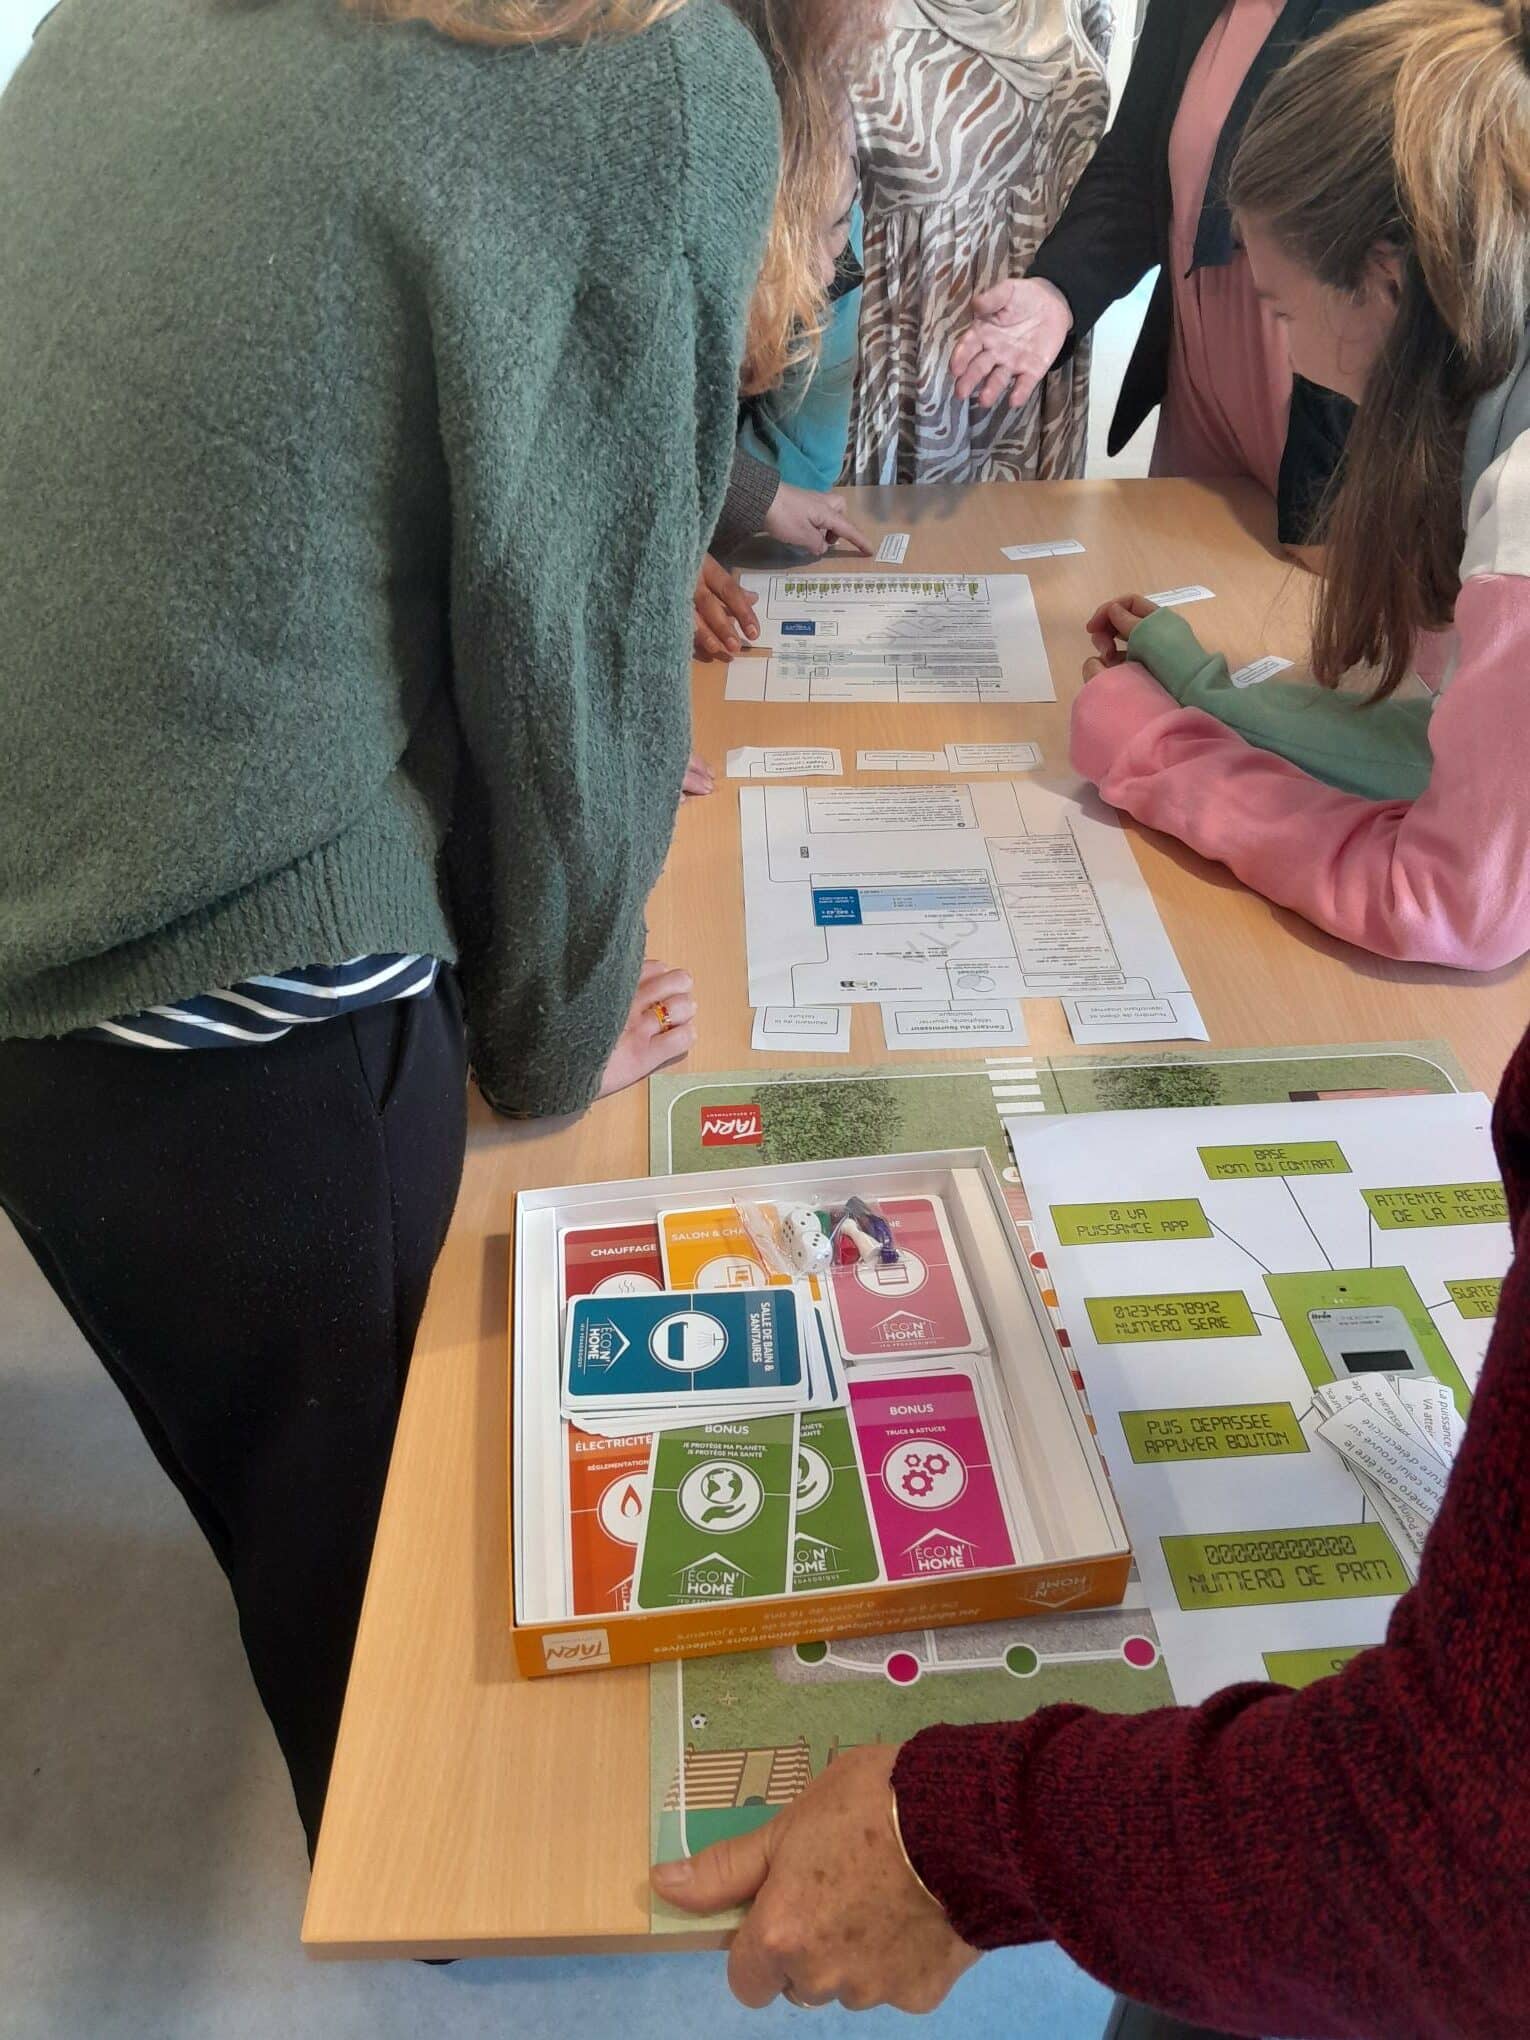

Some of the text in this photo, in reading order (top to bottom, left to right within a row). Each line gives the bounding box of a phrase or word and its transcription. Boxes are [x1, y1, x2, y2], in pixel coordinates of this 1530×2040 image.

[702, 1116, 762, 1139] TARN
[1254, 1148, 1288, 1161] BASE
[1216, 1158, 1337, 1174] NOM DU CONTRAT
[1374, 1187, 1505, 1207] ATTENTE RETOU
[1126, 1208, 1148, 1220] VA
[1392, 1203, 1507, 1224] DE LA TENSIO
[671, 1231, 709, 1241] SALON
[1076, 1220, 1189, 1238] PUISSANCE APP
[591, 1243, 656, 1257] CHAUFFAGE
[1115, 1316, 1231, 1336] NUMERO SERIE
[587, 1328, 601, 1361] HOME
[750, 1313, 762, 1363] SANITAIRES
[761, 1302, 775, 1372] SALLE DE BAIN &
[885, 1330, 926, 1341] HOME
[890, 1403, 934, 1416] BONUS
[704, 1424, 749, 1434] BONUS
[885, 1428, 908, 1437] TRUCS
[915, 1425, 946, 1434] ASTUCES
[1146, 1413, 1272, 1435] PUIS DEPASSEE
[1343, 1420, 1364, 1438] sur
[1144, 1431, 1290, 1454] APPUYER BOUTON
[1342, 1438, 1436, 1516] uméro doit être le
[1396, 1464, 1423, 1487] celui
[794, 1560, 828, 1574] OME
[918, 1558, 965, 1571] HOME
[1187, 1559, 1393, 1594] NUMERO DE PRM
[687, 1583, 734, 1596] HOME
[545, 1641, 609, 1661] TARN
[653, 1640, 724, 1653] collectives
